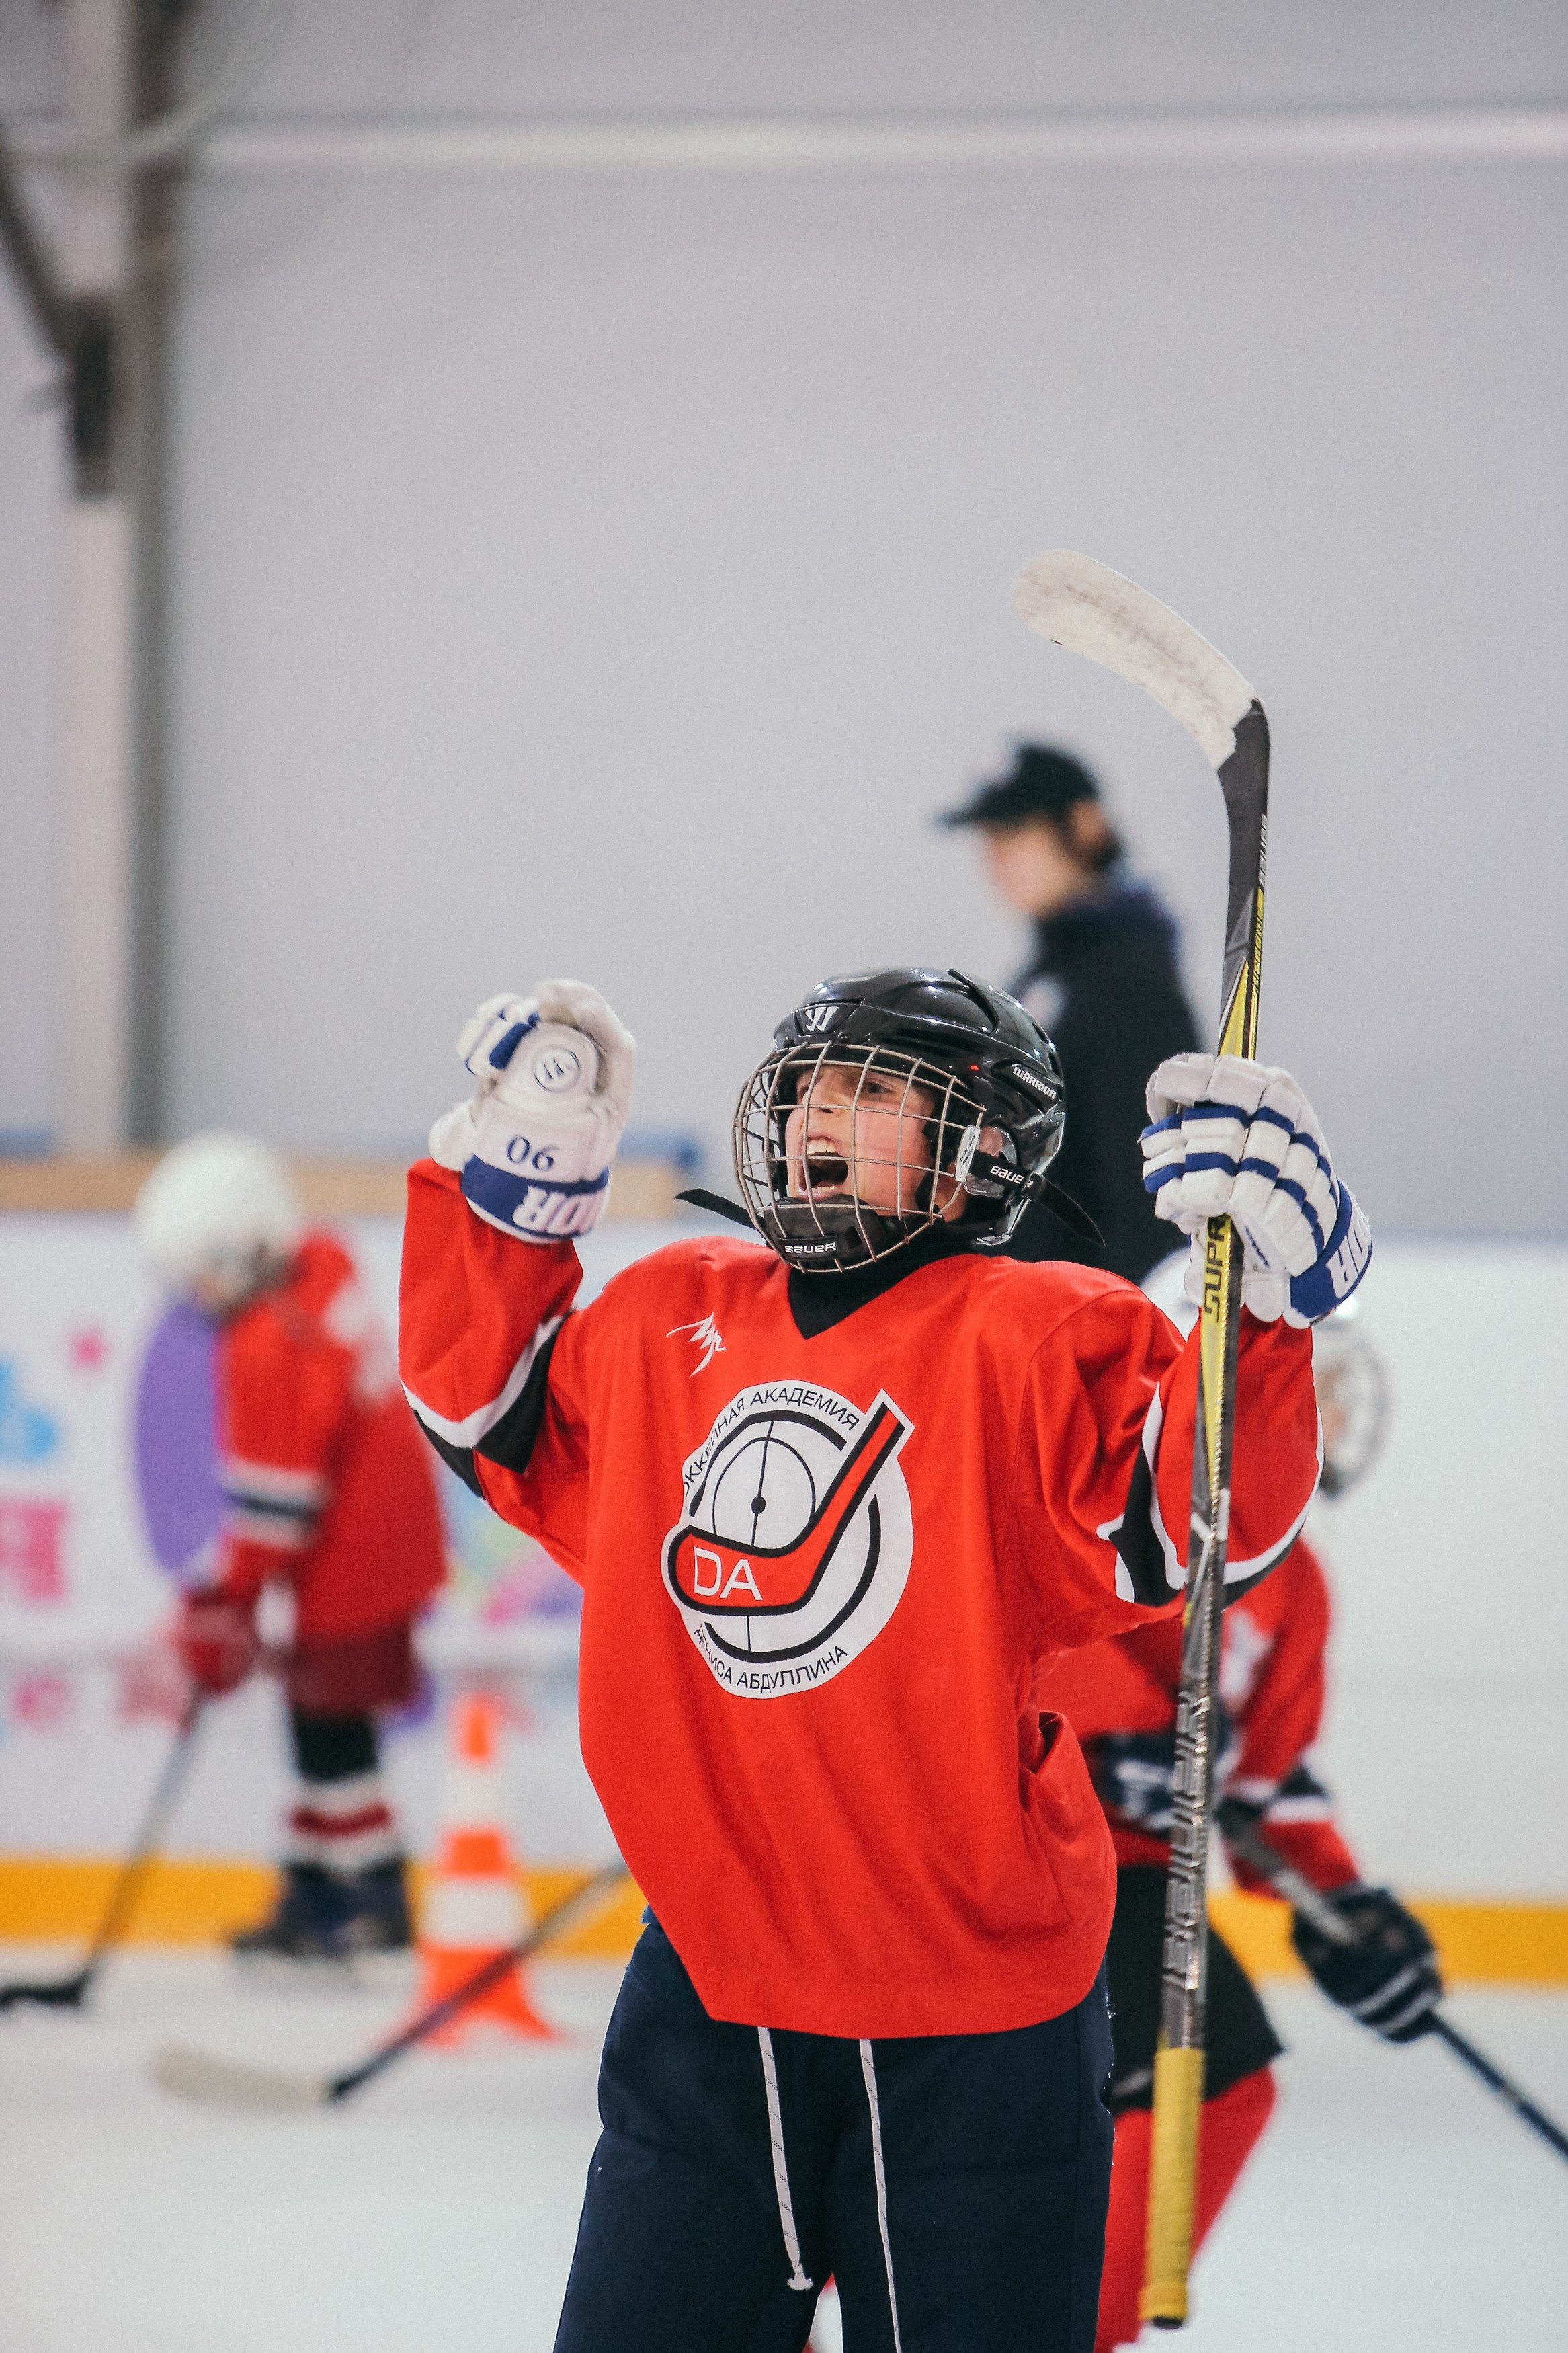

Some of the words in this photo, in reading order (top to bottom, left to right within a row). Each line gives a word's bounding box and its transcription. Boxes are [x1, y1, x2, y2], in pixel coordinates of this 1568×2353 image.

[1012, 1066, 1057, 1100] WARRIOR
[989, 1164, 1034, 1188] BAUER
[749, 1386, 861, 1431] АКАДЕМИЯ
[736, 1645, 849, 1694] АБДУЛЛИНА
